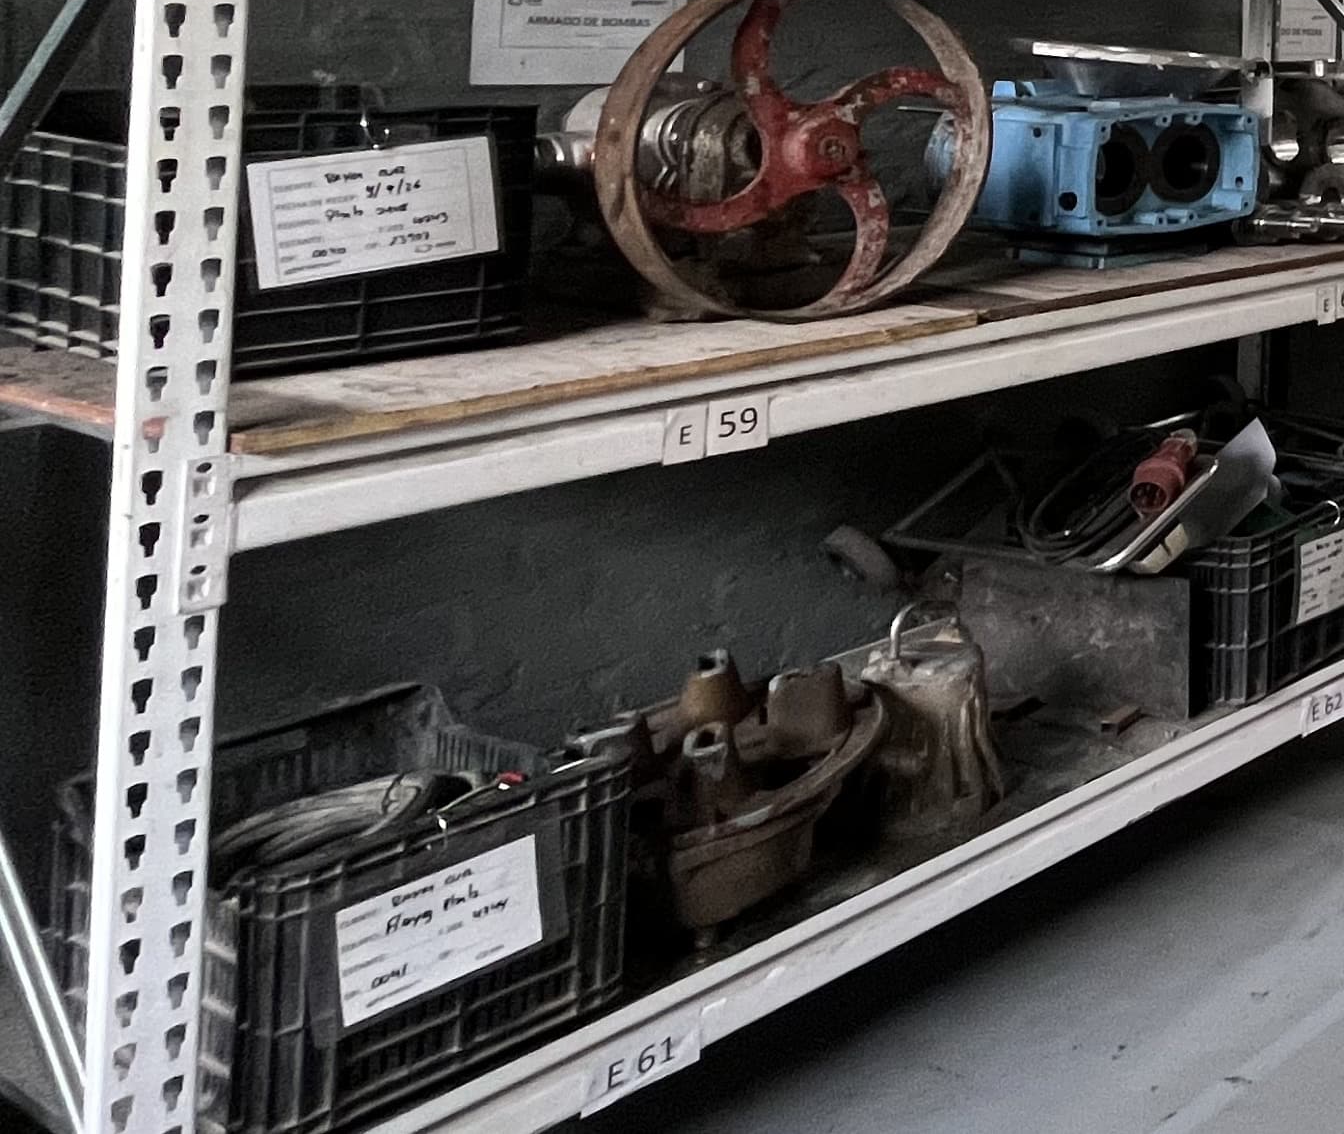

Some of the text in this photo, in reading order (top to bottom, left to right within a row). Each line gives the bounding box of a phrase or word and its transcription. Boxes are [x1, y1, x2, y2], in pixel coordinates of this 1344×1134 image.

[527, 15, 651, 27] ARMADO DE BOMBAS
[1323, 298, 1330, 313] E
[680, 407, 758, 445] E 59
[1312, 692, 1343, 722] E 62
[608, 1035, 676, 1088] E 61
